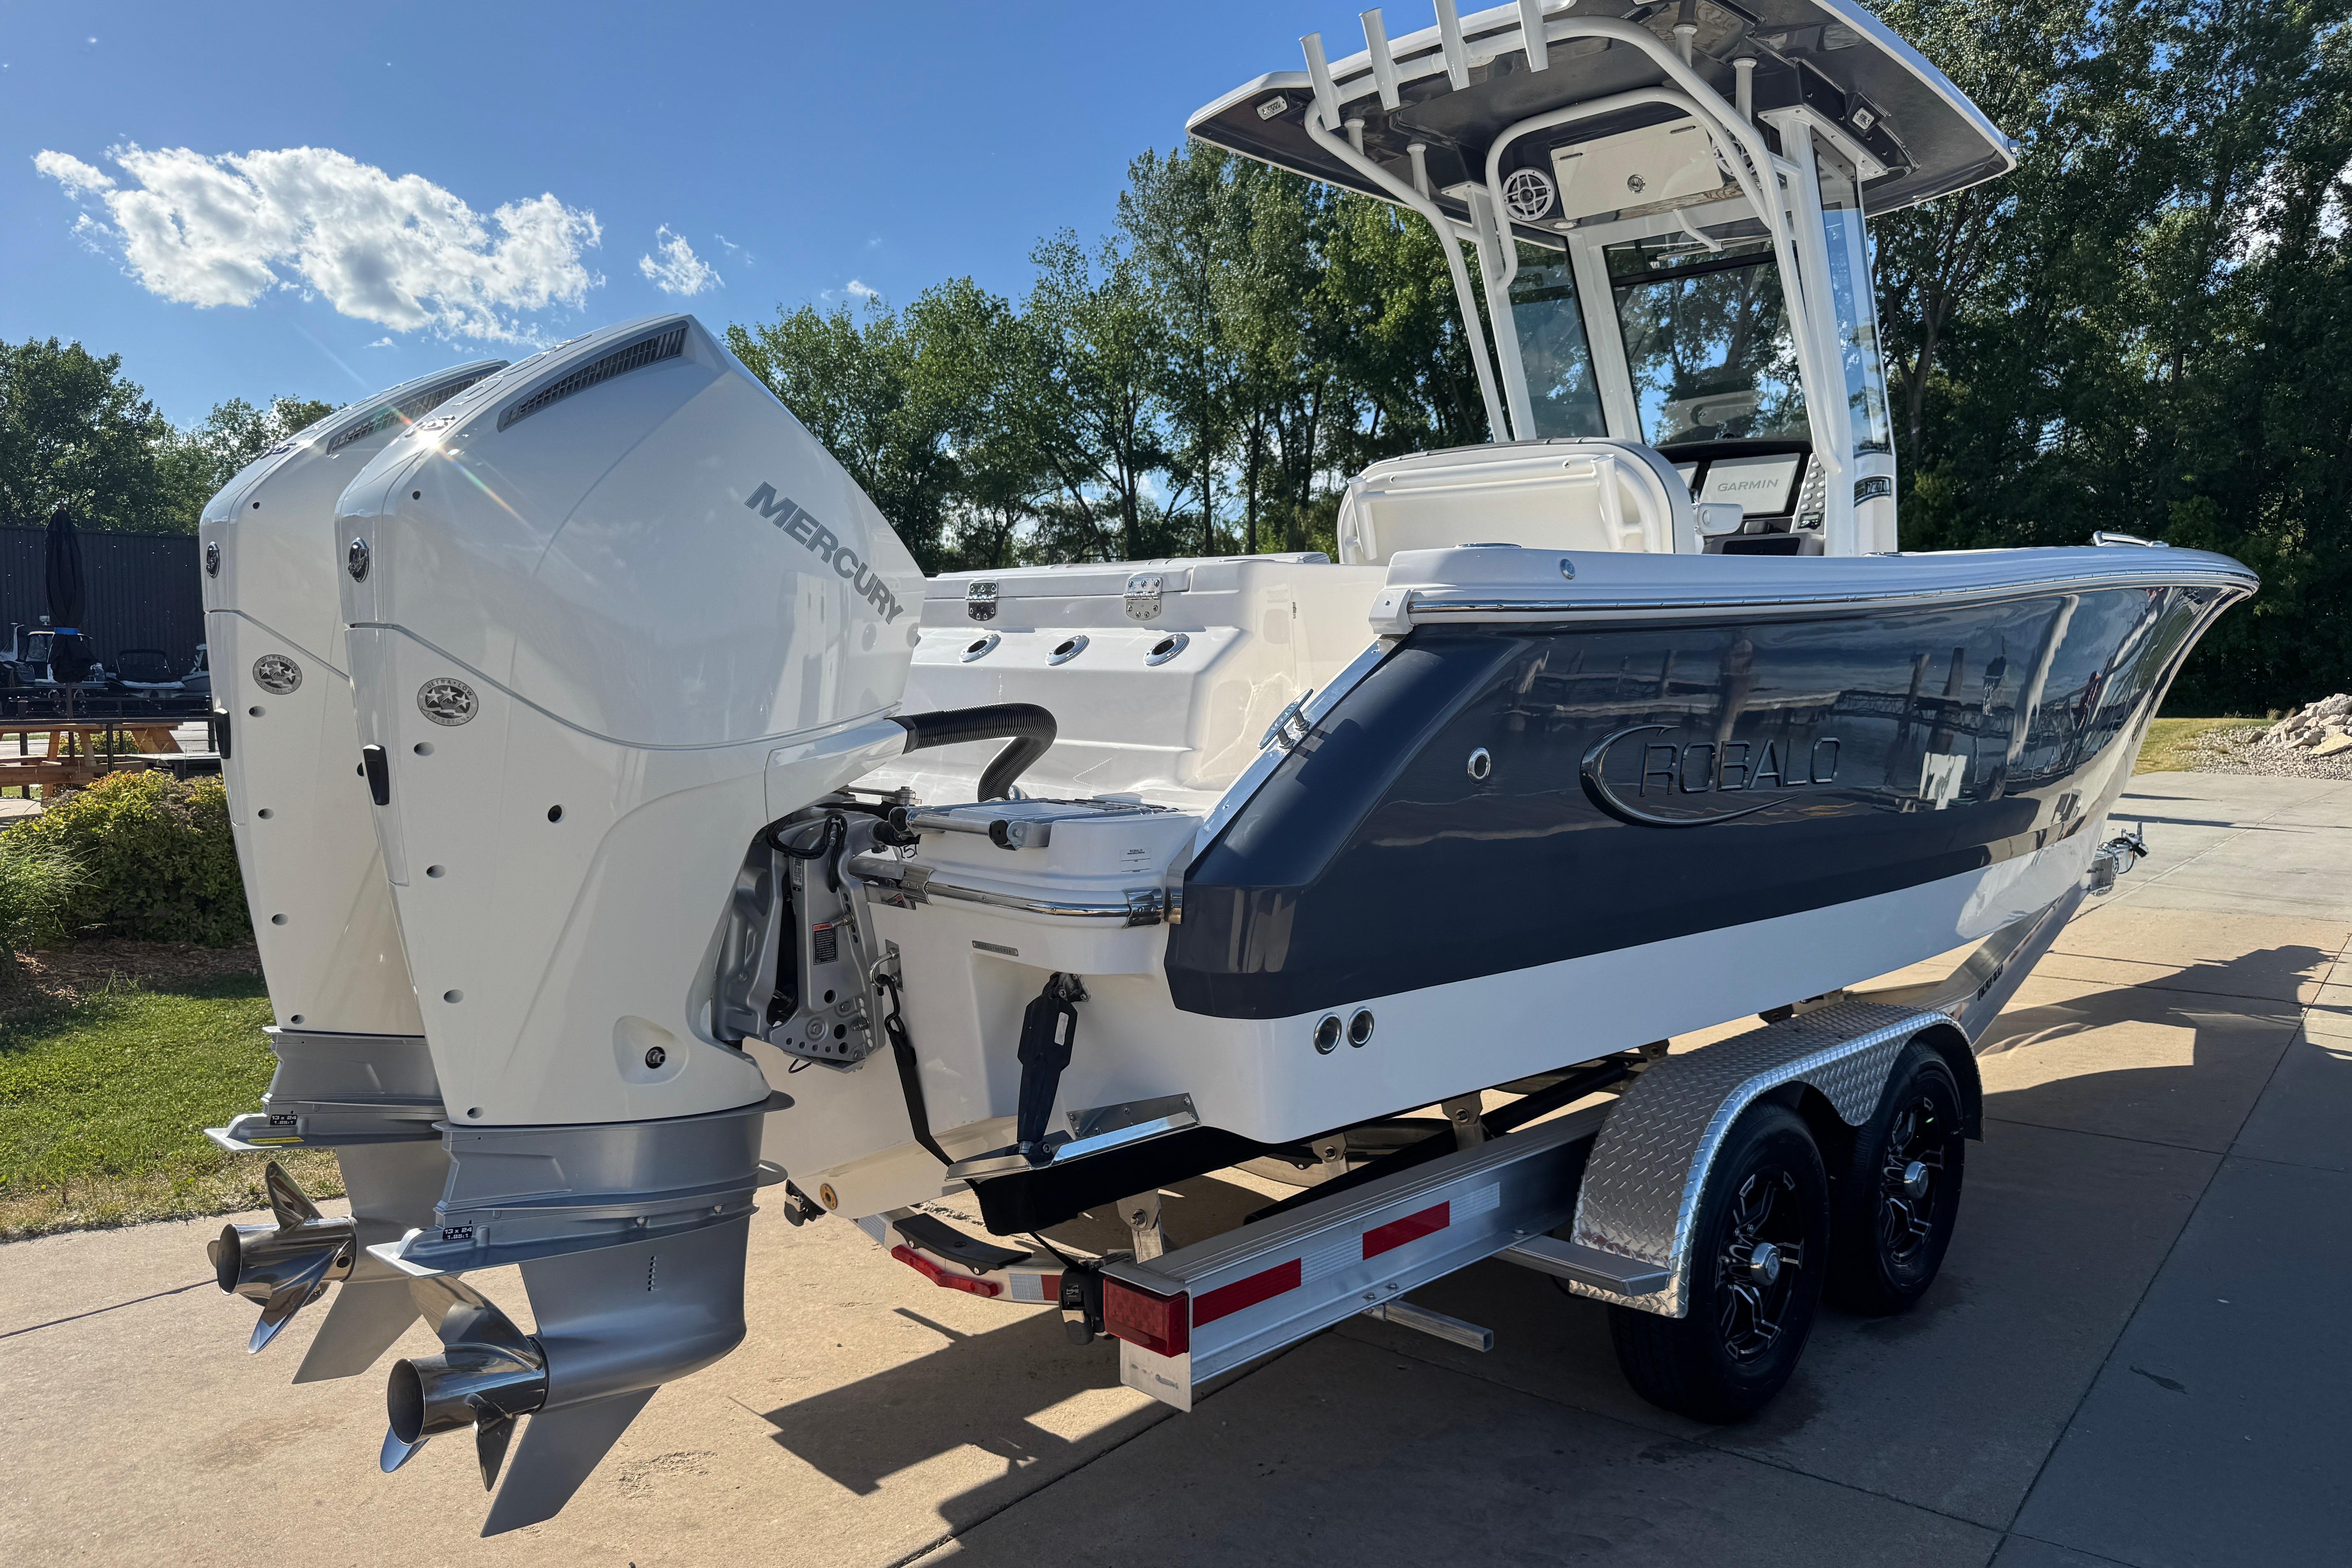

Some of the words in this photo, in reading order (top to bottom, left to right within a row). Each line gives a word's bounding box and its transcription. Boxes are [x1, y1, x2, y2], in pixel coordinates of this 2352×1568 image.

[1717, 479, 1778, 492] GARMIN
[744, 481, 904, 625] MERCURY
[286, 660, 299, 671] LOW
[426, 679, 451, 689] ULTRA
[458, 683, 474, 696] LOW
[1639, 737, 1841, 797] ROBALO
